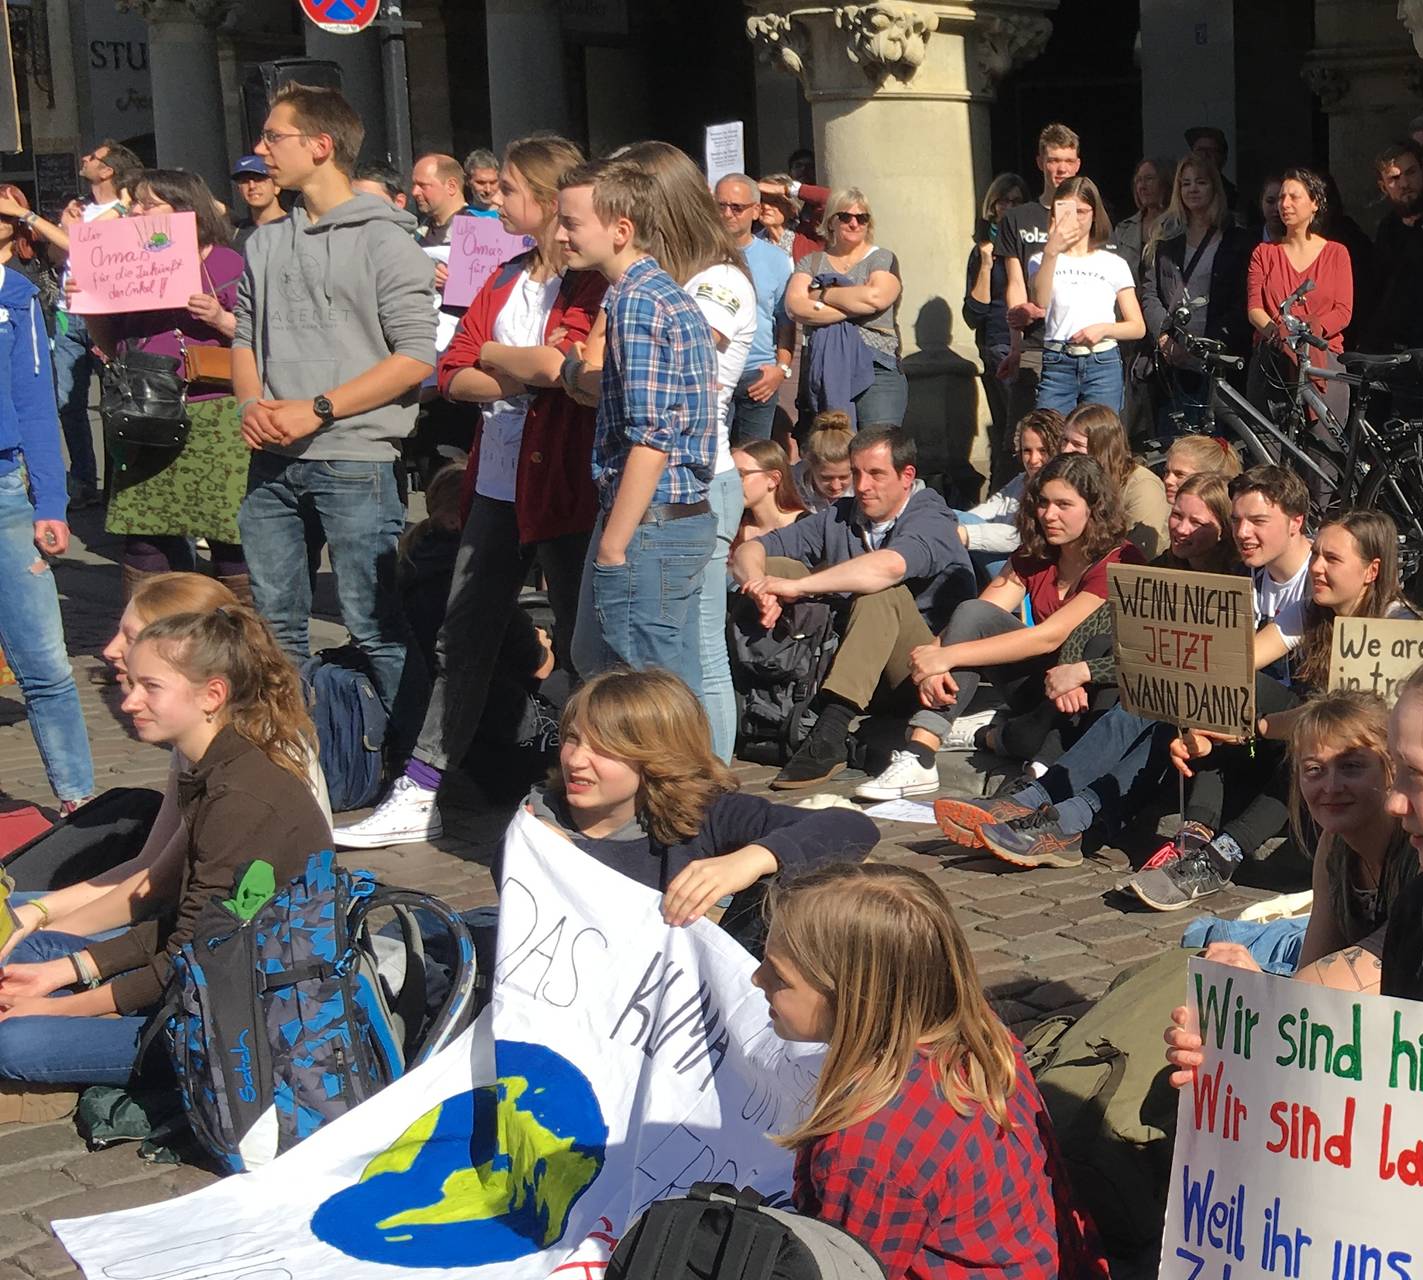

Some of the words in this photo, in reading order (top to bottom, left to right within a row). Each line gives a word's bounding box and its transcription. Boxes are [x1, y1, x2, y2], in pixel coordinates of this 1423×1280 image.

[1113, 576, 1177, 622] WENN
[1183, 584, 1242, 628] NICHT
[1143, 626, 1213, 672] JETZT
[1339, 623, 1381, 659] We
[1122, 673, 1179, 717] WANN
[1195, 973, 1259, 1060] Wir
[1276, 1003, 1362, 1081] sind
[1192, 1061, 1247, 1142] Wir
[1266, 1097, 1356, 1168] sind
[1183, 1165, 1245, 1262] Weil
[1261, 1197, 1312, 1279] ihr
